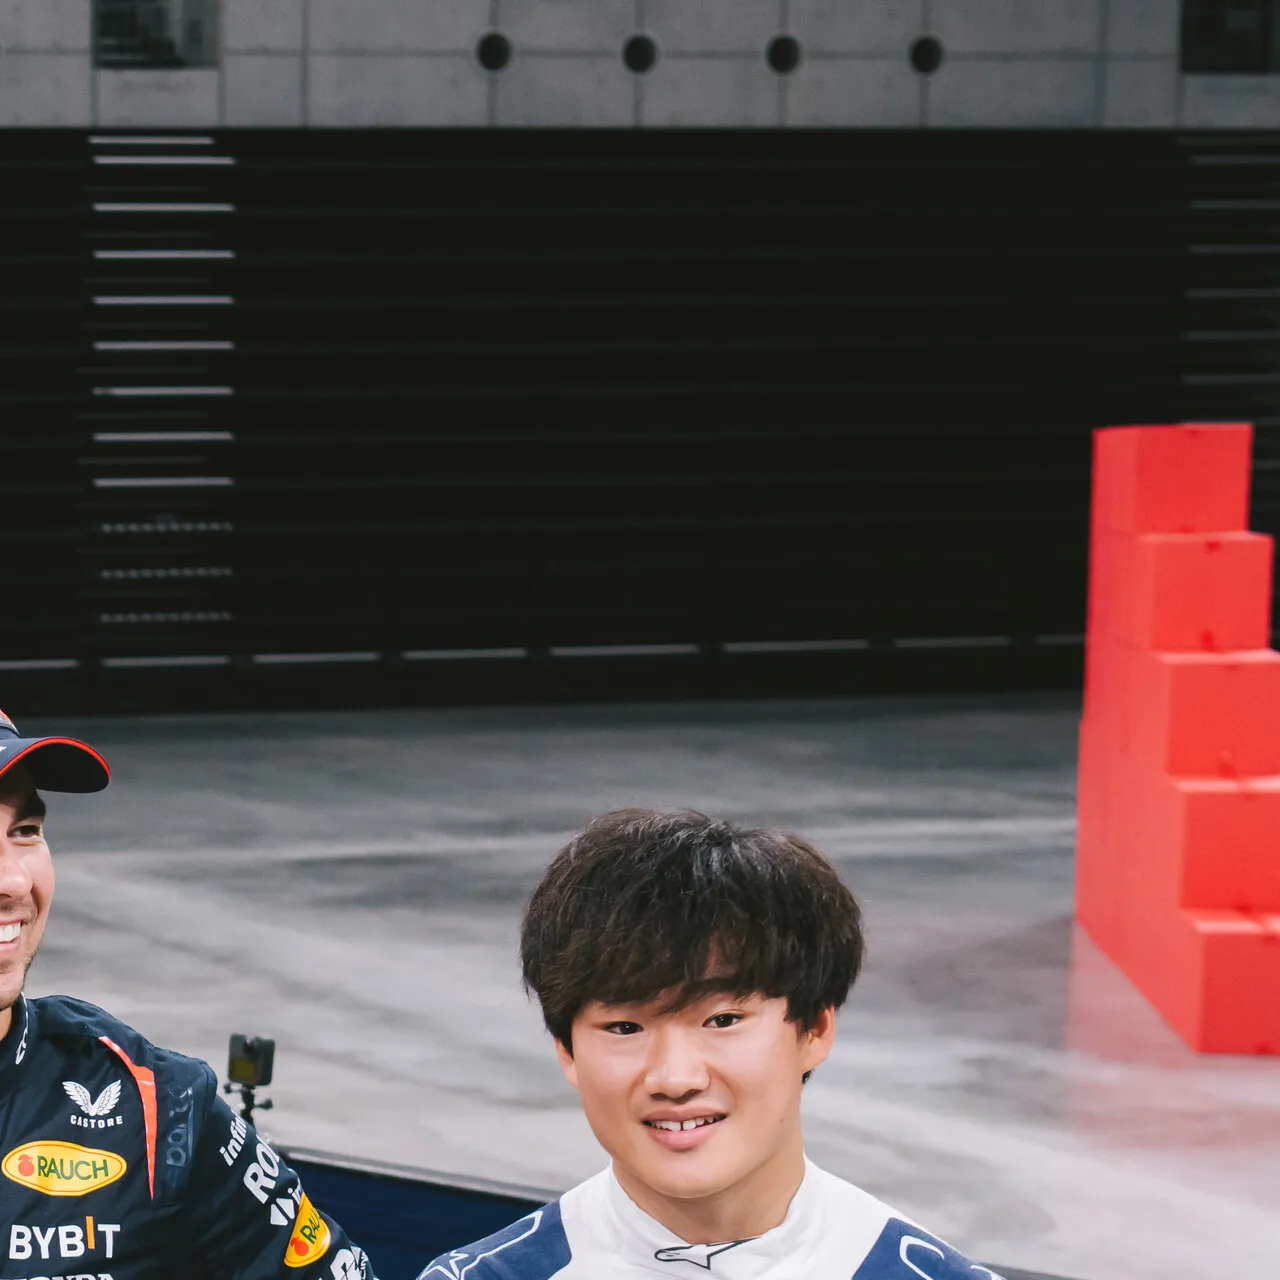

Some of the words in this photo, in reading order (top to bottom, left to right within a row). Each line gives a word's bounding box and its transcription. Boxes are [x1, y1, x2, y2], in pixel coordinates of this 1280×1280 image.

[70, 1114, 124, 1129] CASTORE
[37, 1155, 109, 1181] RAUCH
[9, 1216, 121, 1260] BYBIT
